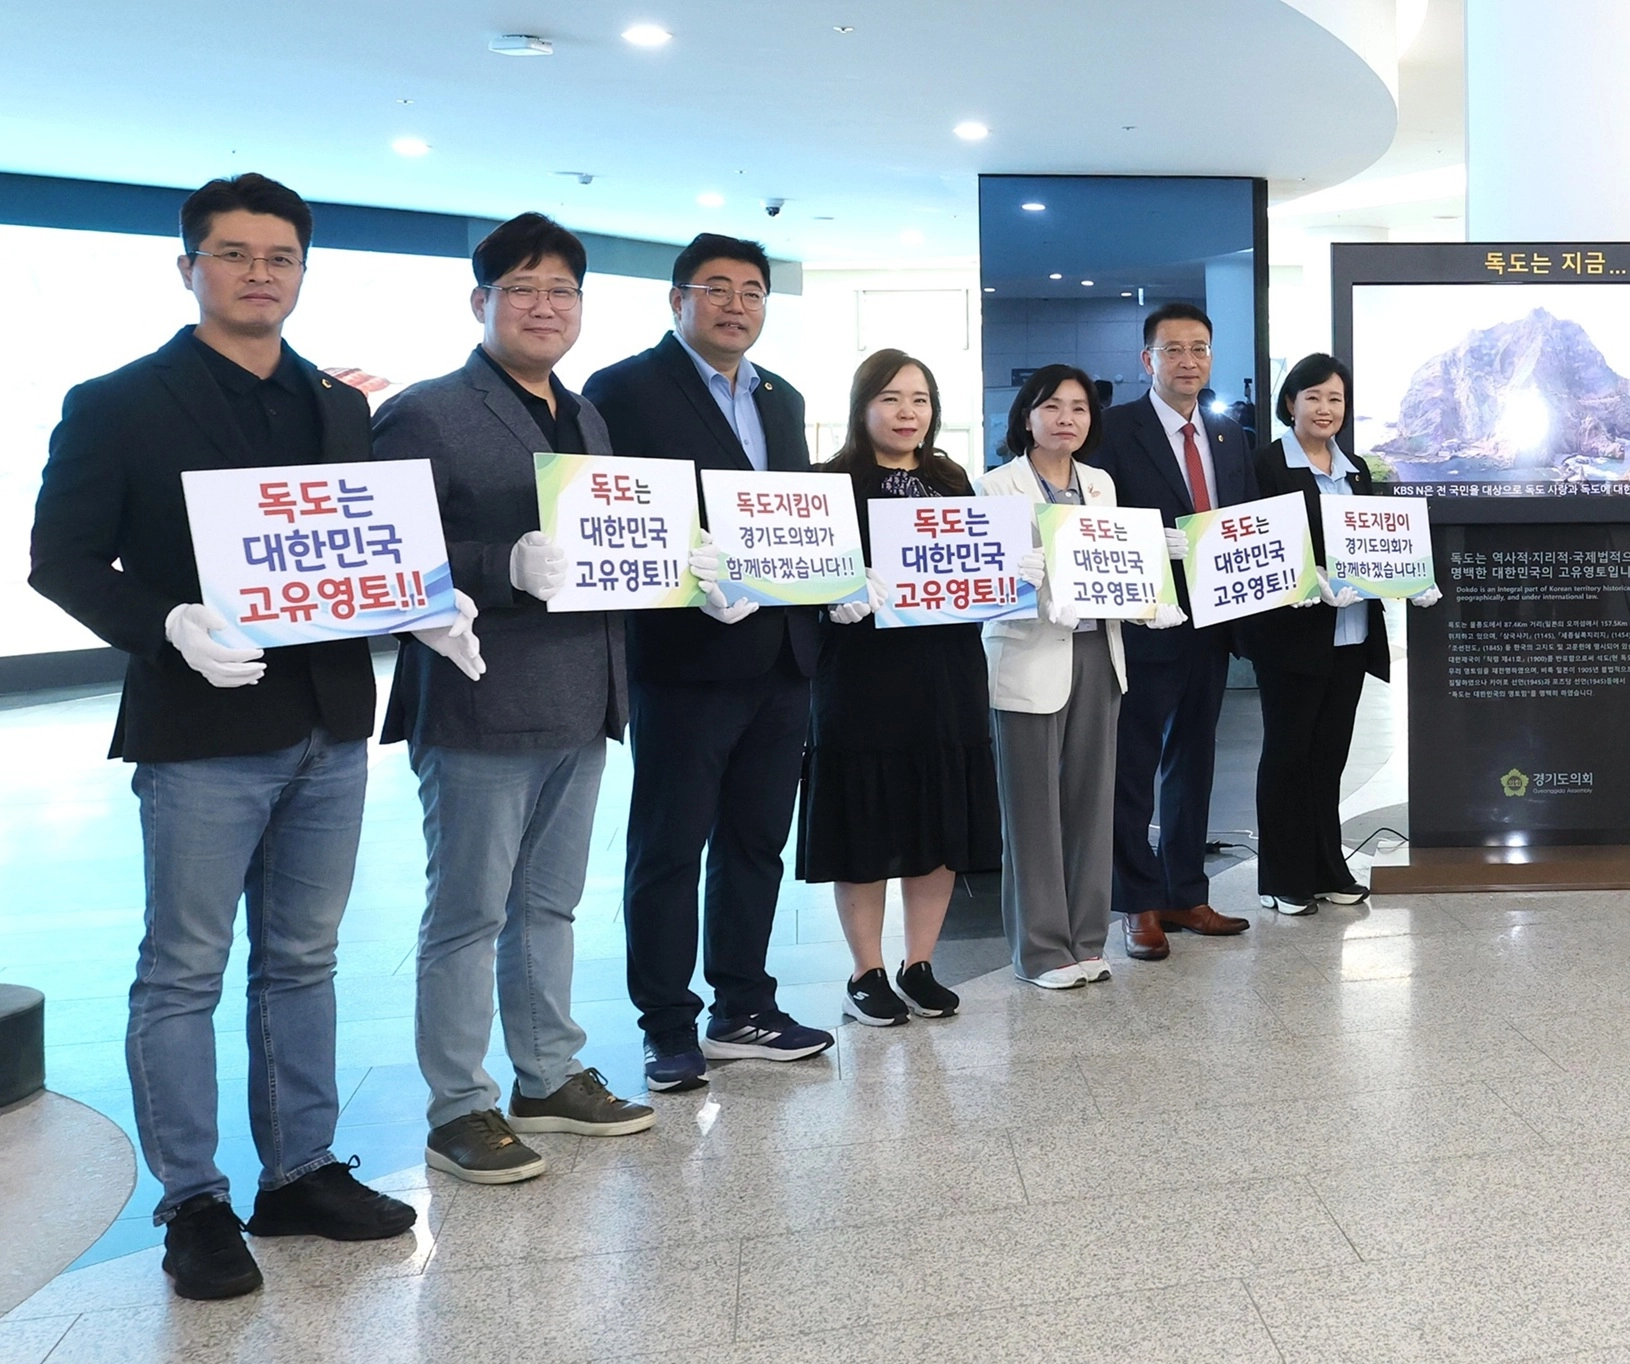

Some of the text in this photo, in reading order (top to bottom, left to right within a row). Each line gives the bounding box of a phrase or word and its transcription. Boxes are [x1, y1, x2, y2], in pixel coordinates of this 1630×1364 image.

[1485, 252, 1626, 274] 독도는 지금...
[258, 479, 373, 523] 독도는
[592, 473, 651, 505] 독도는
[1394, 486, 1413, 495] KBS
[1416, 486, 1433, 496] N은
[1437, 486, 1446, 495] 전
[1449, 486, 1479, 495] 국민을
[1482, 486, 1522, 495] 대상으로
[1525, 484, 1546, 496] 독도
[1548, 484, 1578, 495] 사랑과
[1581, 484, 1610, 495] 독도에
[737, 492, 829, 518] 독도지킴이
[580, 516, 667, 548] 대한민국
[914, 508, 989, 538] 독도는
[1080, 518, 1127, 542] 독도는
[1221, 516, 1269, 542] 독도는
[1344, 511, 1409, 531] 독도지킴이
[243, 524, 402, 572] 대한민국
[739, 527, 834, 548] 경기도의회가
[1346, 538, 1412, 554] 경기도의회가
[727, 557, 854, 579] 함께하겠습니다!!
[902, 542, 1005, 574] 대한민국
[1074, 549, 1143, 574] 대한민국
[1215, 540, 1285, 575] 대한민국
[1336, 562, 1426, 578] 함께하겠습니다!!
[1450, 552, 1487, 565] 독도는
[576, 560, 679, 591] 고유영토!!
[1451, 567, 1487, 580] 명백한
[1492, 566, 1553, 579] 대한민국의
[240, 571, 426, 622] 고유영토!!
[895, 577, 1016, 609] 고유영토!!
[1074, 582, 1156, 605] 고유영토!!
[1214, 568, 1297, 606] 고유영토!!
[1524, 586, 1538, 594] part
[1533, 772, 1593, 786] 경기도의회
